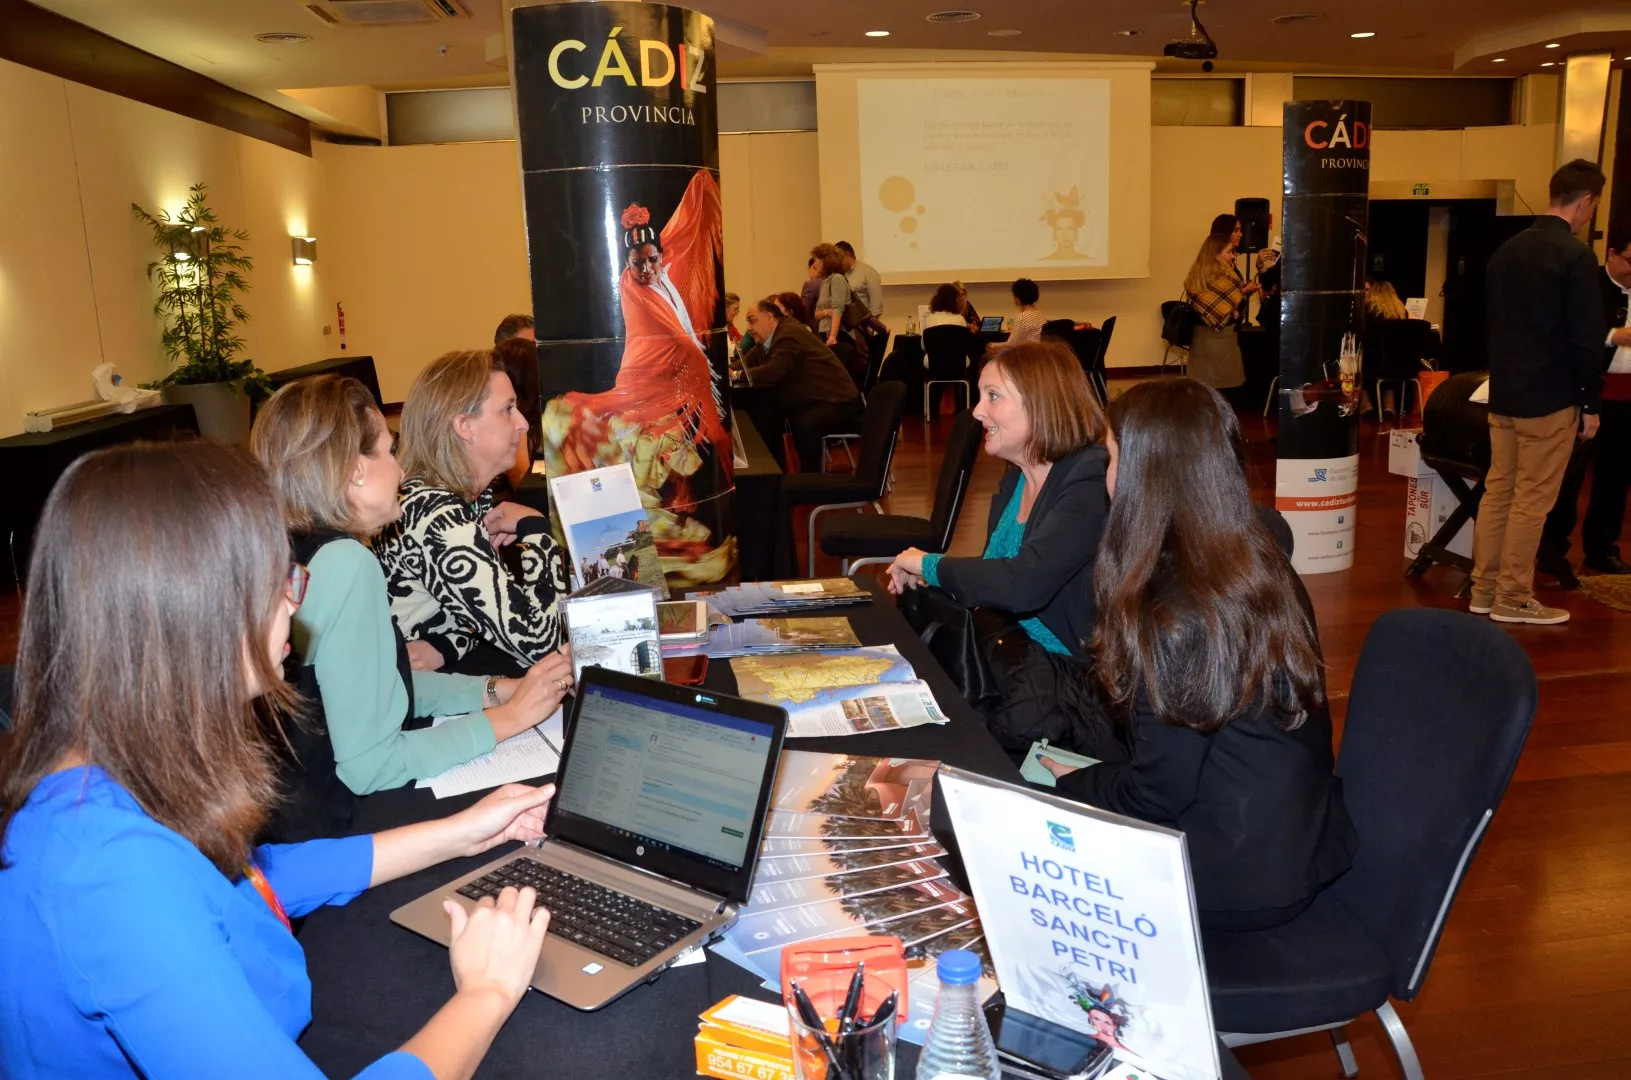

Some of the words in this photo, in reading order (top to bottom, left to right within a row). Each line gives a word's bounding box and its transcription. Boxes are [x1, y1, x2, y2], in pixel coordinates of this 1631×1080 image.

[548, 26, 707, 94] CÁDIZ
[581, 105, 696, 125] PROVINCIA
[1408, 477, 1418, 517] TAPONES
[1420, 491, 1429, 509] SUR
[1020, 851, 1124, 900] HOTEL
[1009, 875, 1158, 938] BARCELÓ
[1030, 908, 1139, 960] SANCTI
[1052, 940, 1137, 984] PETRI
[707, 1053, 732, 1071] 954
[736, 1061, 753, 1075] 67
[757, 1066, 776, 1080] 67
